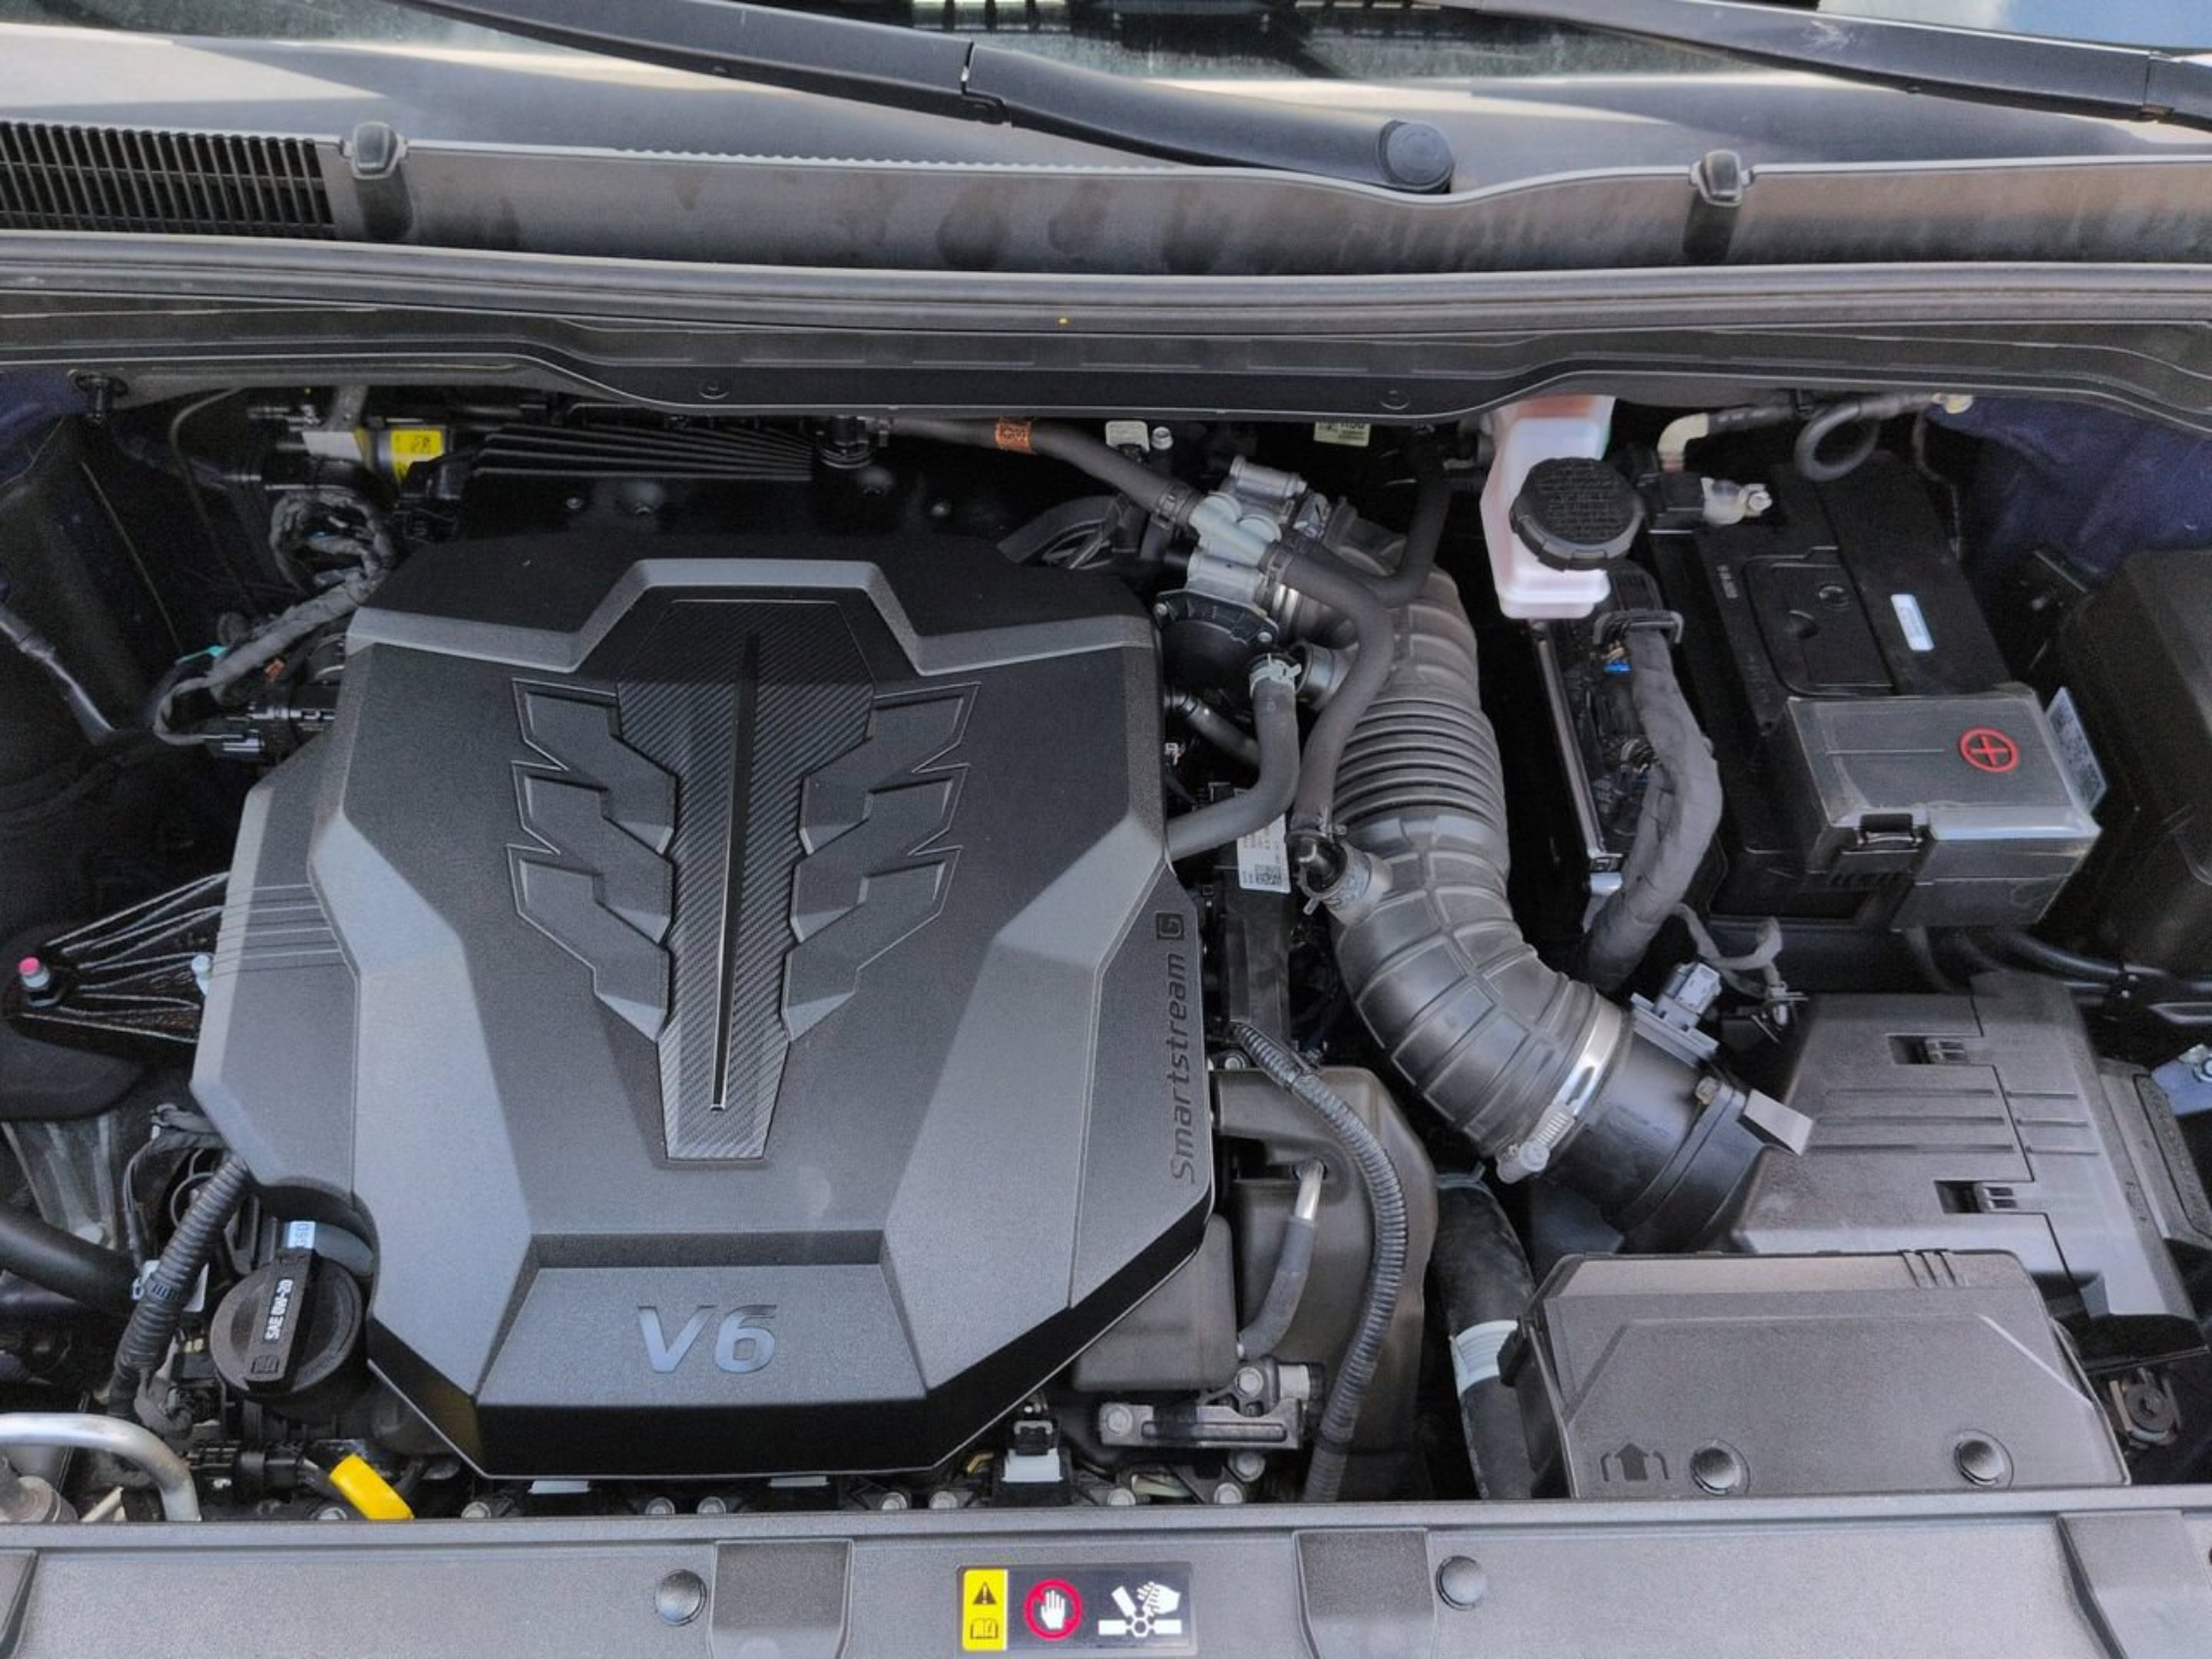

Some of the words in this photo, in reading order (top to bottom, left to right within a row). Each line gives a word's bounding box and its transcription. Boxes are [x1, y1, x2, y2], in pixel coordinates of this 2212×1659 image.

[1167, 953, 1194, 1184] Smartstream
[265, 1316, 284, 1339] SAE
[637, 1304, 777, 1374] V6
